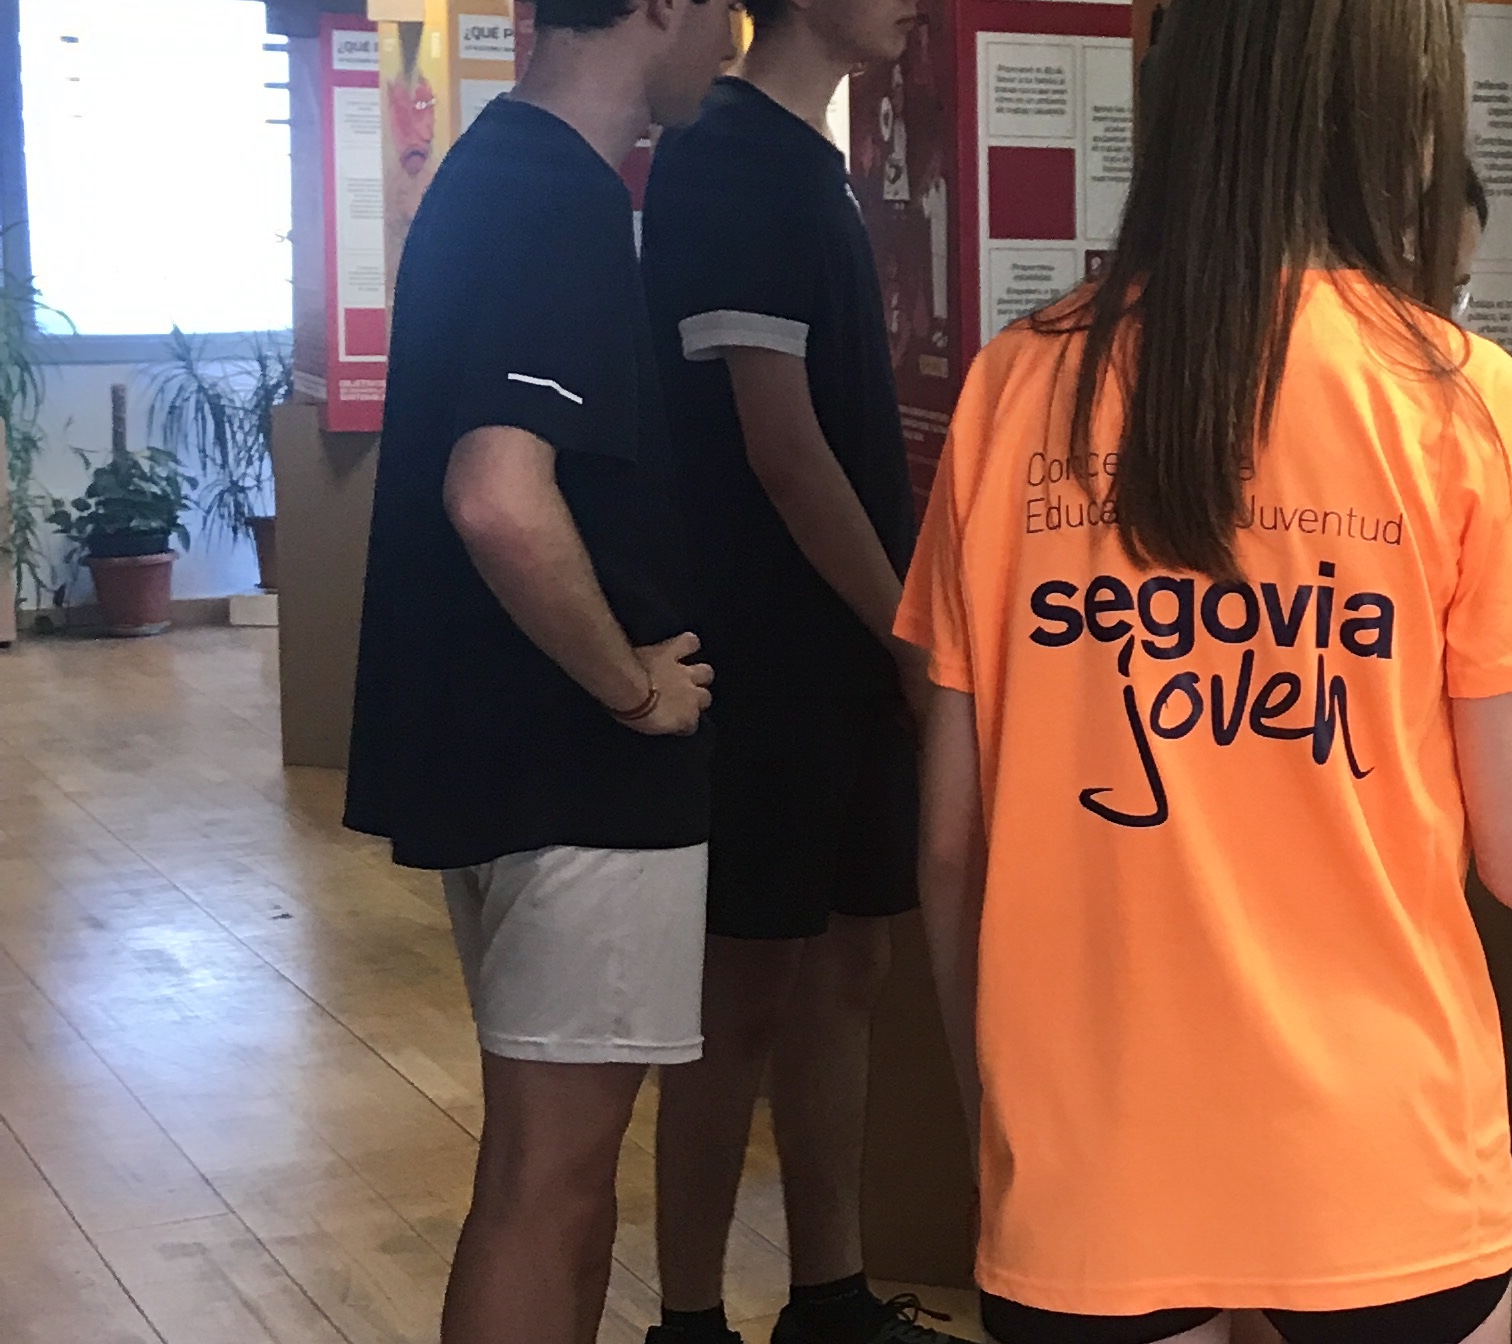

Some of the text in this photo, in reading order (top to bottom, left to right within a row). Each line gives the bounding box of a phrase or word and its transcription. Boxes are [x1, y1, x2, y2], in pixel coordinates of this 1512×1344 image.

[1234, 493, 1404, 548] Juventud
[1028, 559, 1396, 661] segovia
[1078, 634, 1376, 830] joven
